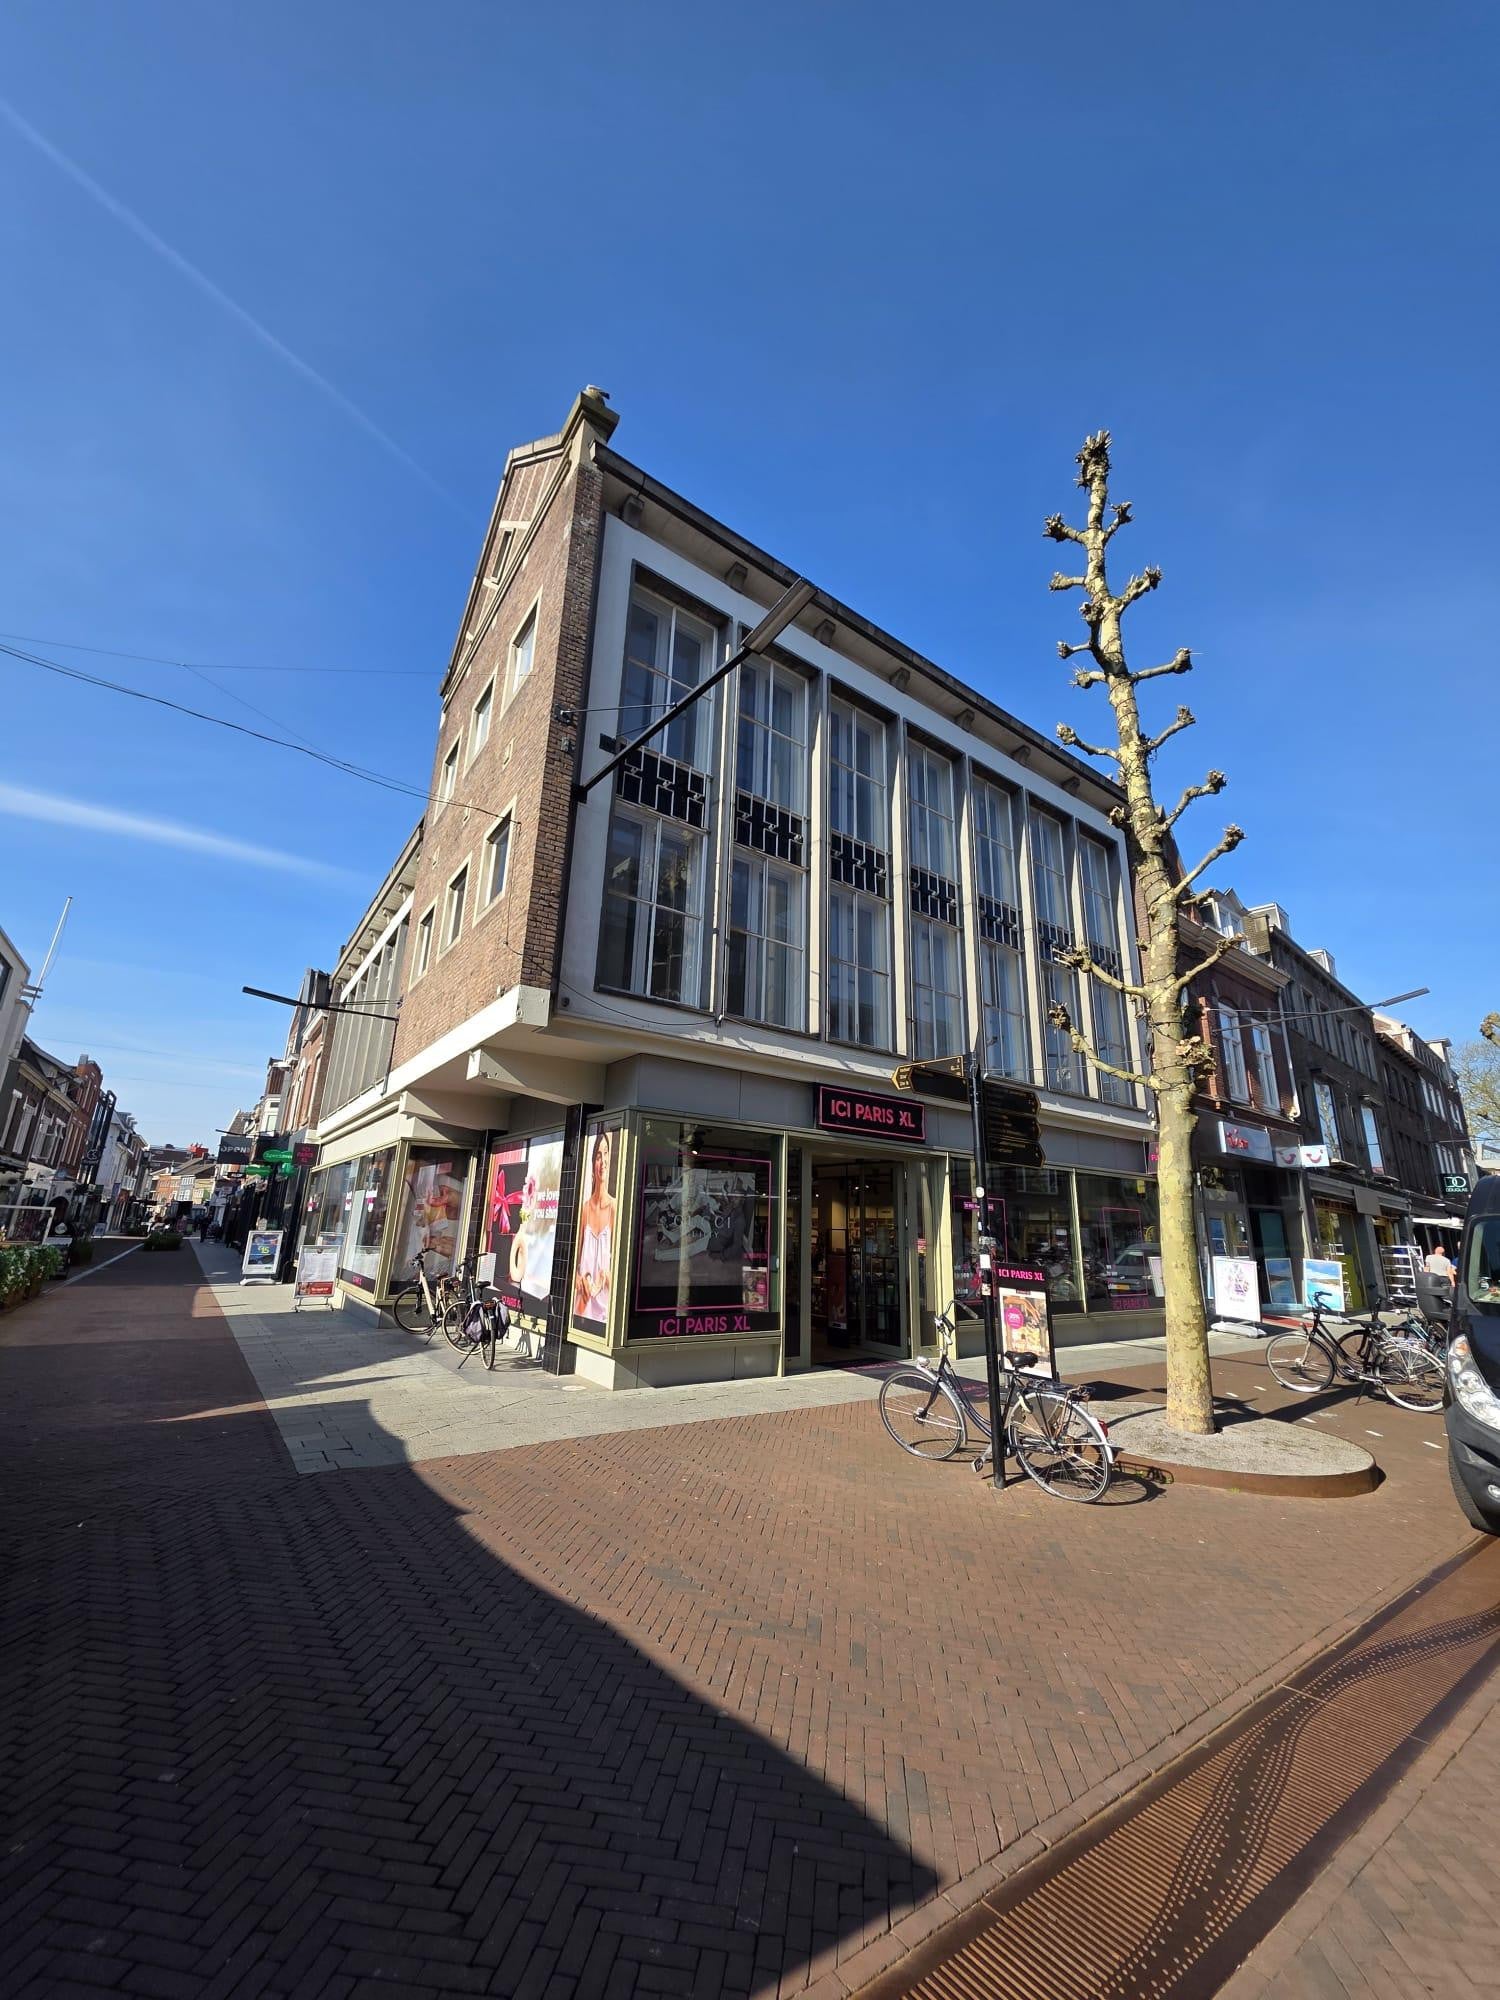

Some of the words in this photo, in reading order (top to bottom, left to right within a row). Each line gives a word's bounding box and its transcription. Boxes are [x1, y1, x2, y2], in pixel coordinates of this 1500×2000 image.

[831, 1099, 851, 1118] ICI
[855, 1103, 895, 1125] PARIS
[899, 1110, 916, 1128] XL
[998, 1268, 1010, 1278] ICI
[1010, 1269, 1033, 1280] PARIS
[1034, 1272, 1045, 1281] XL
[658, 1318, 681, 1336] ICI
[685, 1317, 728, 1334] PARIS
[733, 1315, 751, 1331] XL
